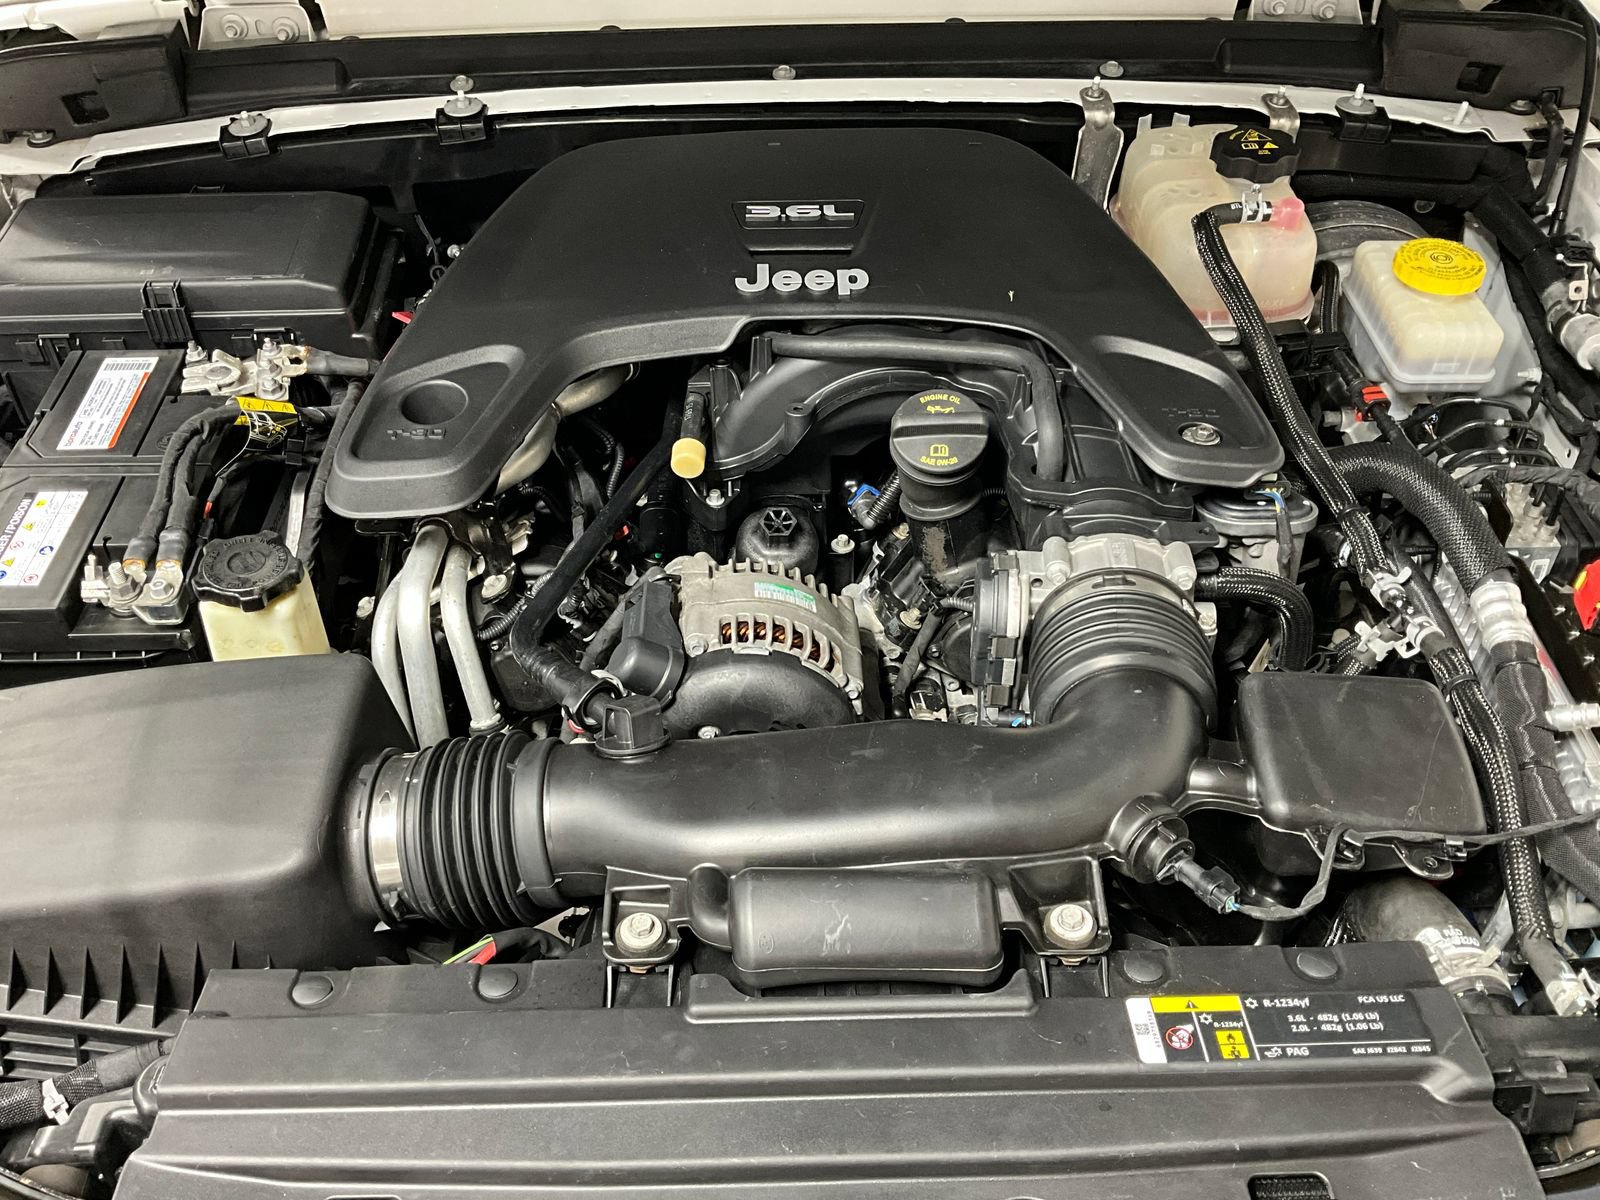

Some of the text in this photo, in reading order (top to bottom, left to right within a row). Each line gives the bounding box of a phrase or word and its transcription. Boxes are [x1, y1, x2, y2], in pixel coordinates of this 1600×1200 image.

[745, 204, 855, 221] 3.6L
[734, 263, 870, 296] Jeep
[919, 393, 961, 405] ENGINE OIL
[920, 455, 958, 466] SAE 0W-20
[1263, 997, 1310, 1009] R-1234yf
[1357, 994, 1405, 1004] FCA US LLC
[1287, 1014, 1307, 1022] 3.6L
[1317, 1012, 1339, 1022] 482g
[1341, 1011, 1364, 1021] (1.06
[1364, 1011, 1380, 1021] Lb)
[1213, 1019, 1244, 1028] R-1234yf
[1291, 1024, 1311, 1032] 2.0L
[1321, 1022, 1343, 1032] 482g
[1345, 1022, 1369, 1032] (1.06
[1368, 1021, 1384, 1031] Lb)
[1286, 1046, 1310, 1056] PAG
